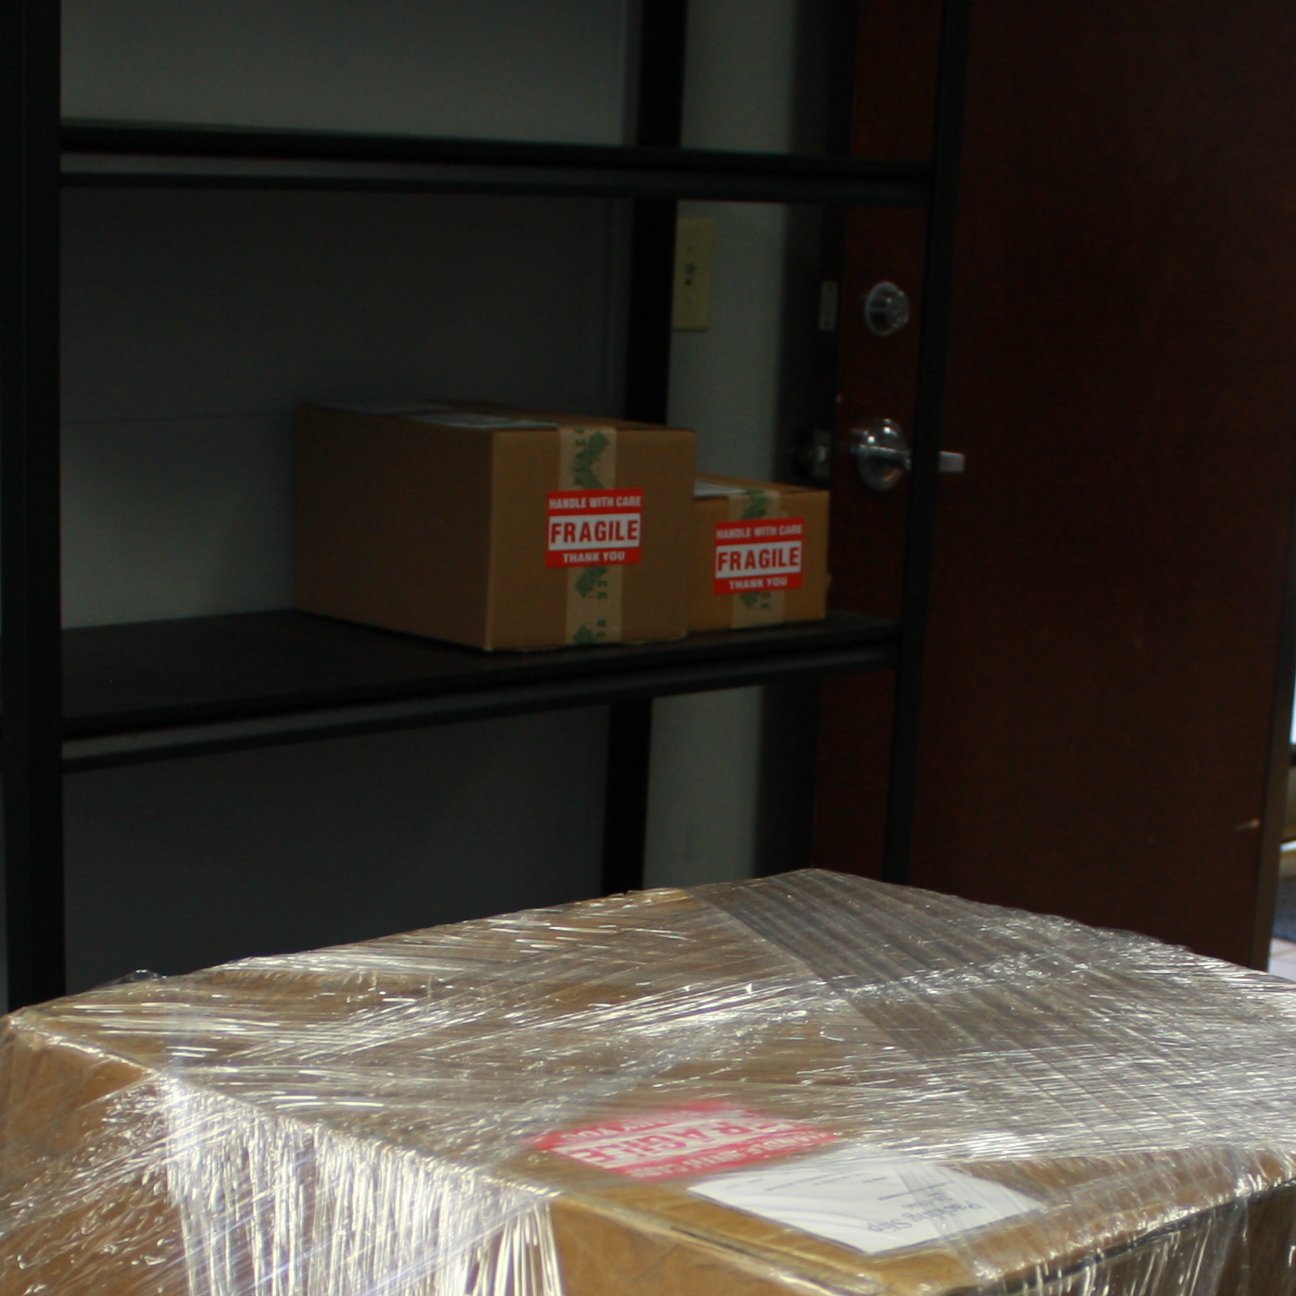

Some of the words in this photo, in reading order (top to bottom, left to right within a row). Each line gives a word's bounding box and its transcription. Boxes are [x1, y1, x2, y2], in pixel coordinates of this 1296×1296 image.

[548, 496, 586, 510] HANDLE
[589, 495, 615, 508] WITH
[616, 494, 642, 507] CARE
[550, 519, 640, 543] FRAGILE
[716, 525, 752, 539] HANDLE
[754, 524, 776, 537] WITH
[777, 523, 803, 535] CARE
[563, 551, 600, 563] THANK
[602, 550, 626, 562] YOU
[717, 547, 800, 571] FRAGILE
[729, 578, 764, 590] THANK
[766, 576, 788, 588] YOU
[569, 1120, 784, 1166] FRAGILE
